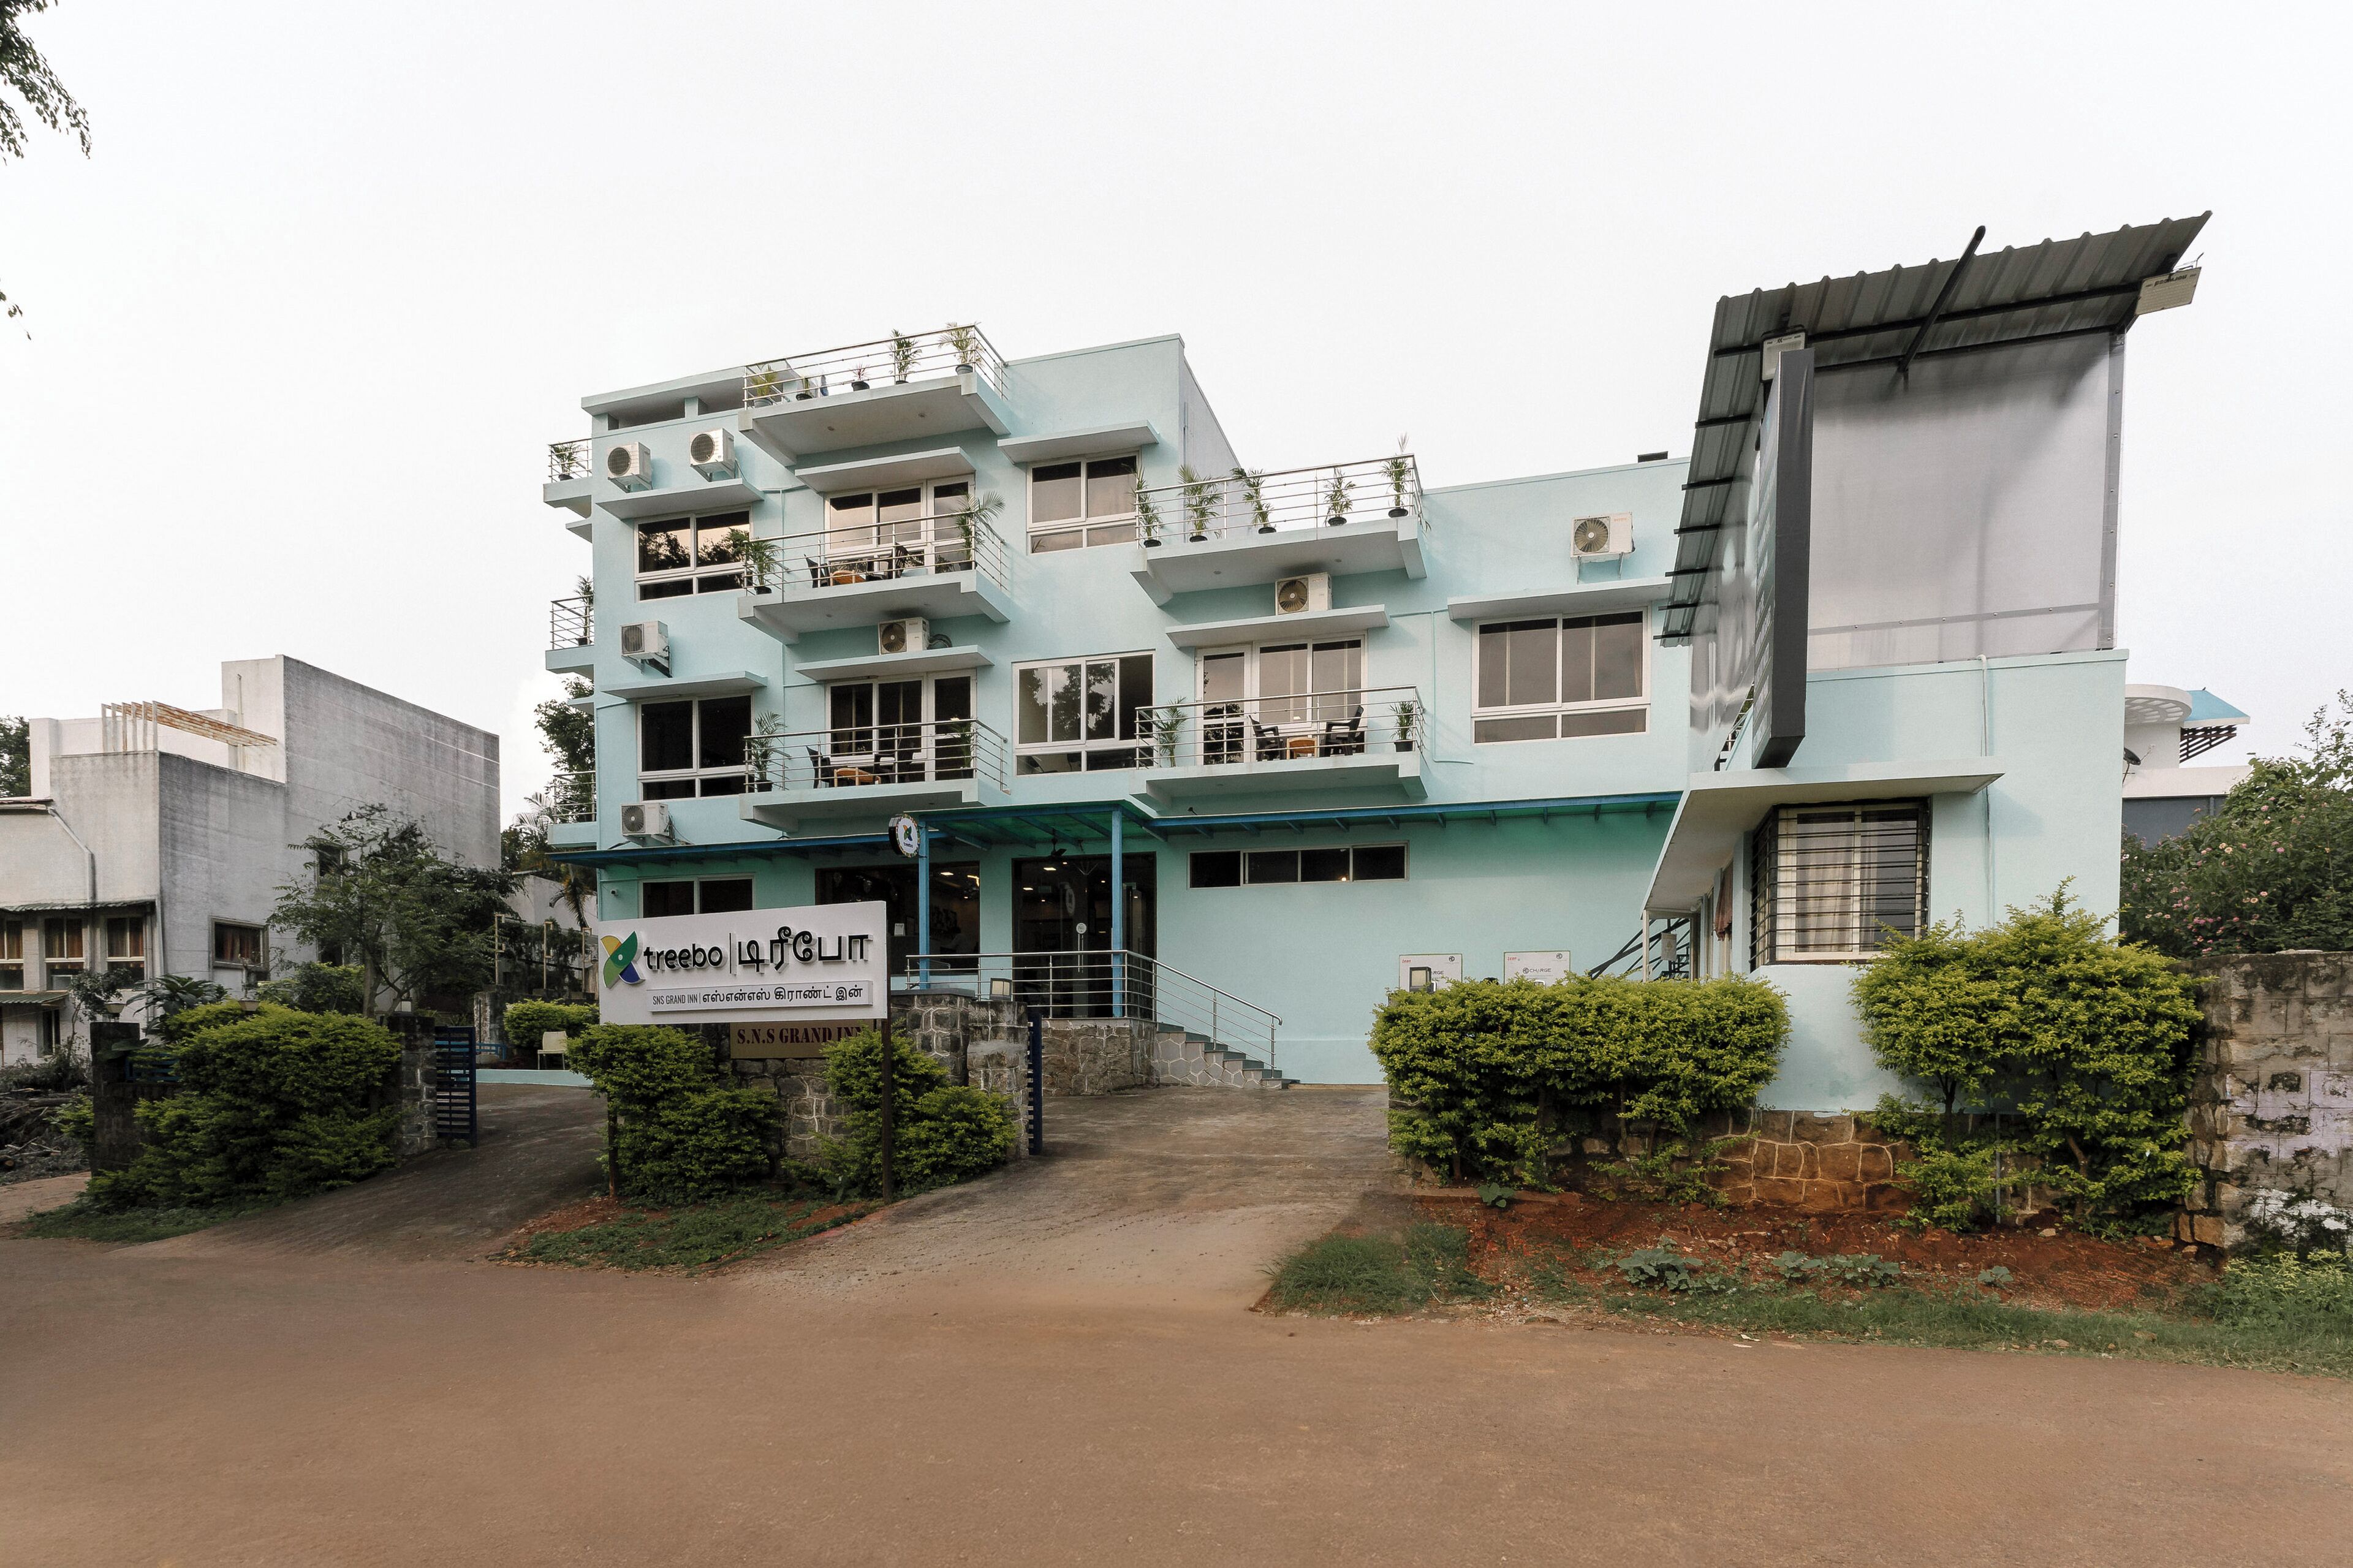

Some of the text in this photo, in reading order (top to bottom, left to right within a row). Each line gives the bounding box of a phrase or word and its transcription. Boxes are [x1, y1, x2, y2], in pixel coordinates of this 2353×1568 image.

[643, 943, 724, 970] treebo
[738, 925, 869, 973] டிரீபோ
[653, 993, 698, 1005] SNS GRAND INN
[835, 983, 863, 1001] இன்
[737, 1028, 775, 1044] S.N.S
[779, 1027, 833, 1044] GRAND
